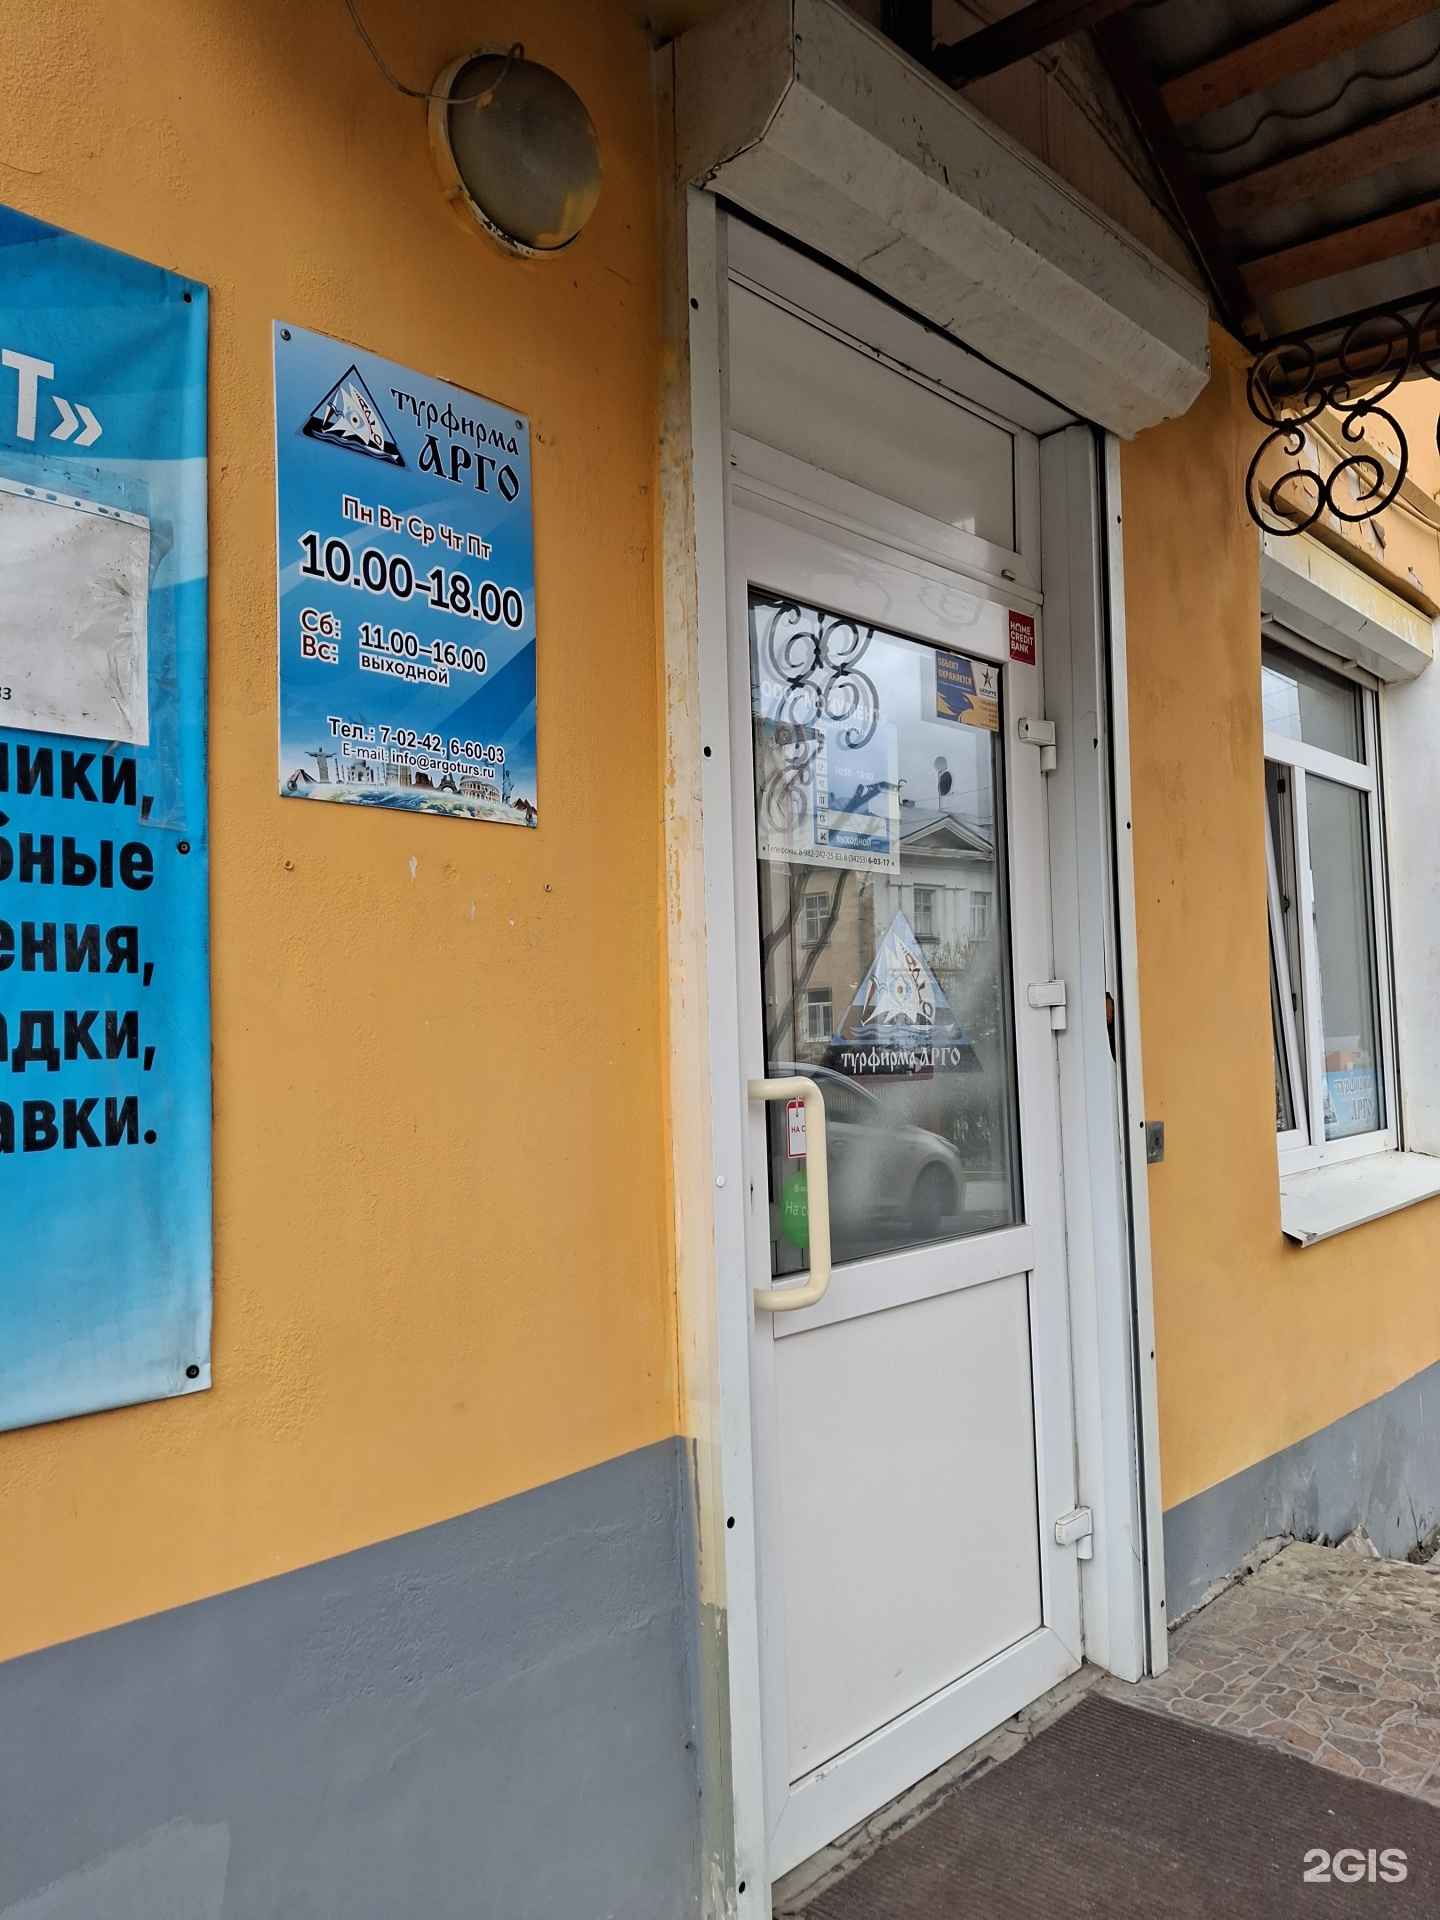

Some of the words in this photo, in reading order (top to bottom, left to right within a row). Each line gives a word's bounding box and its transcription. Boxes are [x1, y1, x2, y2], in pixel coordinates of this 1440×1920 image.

[419, 435, 520, 502] АРГО
[343, 496, 373, 524] Пн
[380, 507, 402, 532] Вт
[408, 518, 435, 544] Ср
[439, 527, 463, 551] Чт
[468, 535, 492, 559] Пт
[300, 532, 524, 630] 10.00-18.00
[301, 609, 341, 638] Сб:
[1010, 621, 1031, 635] HOME
[1010, 631, 1034, 646] CREDIT
[302, 635, 338, 663] Вс:
[360, 653, 449, 687] выходной
[1010, 641, 1029, 654] BANK
[328, 717, 375, 742] Тел.:
[380, 726, 447, 756] 7-02-42,
[450, 738, 505, 764] 6-60-03
[343, 742, 390, 762] E-mail:
[392, 750, 495, 779] info@argoturs.ru
[0, 741, 155, 819] ики,
[0, 1009, 156, 1072] дки,
[920, 1046, 961, 1067] АРГО
